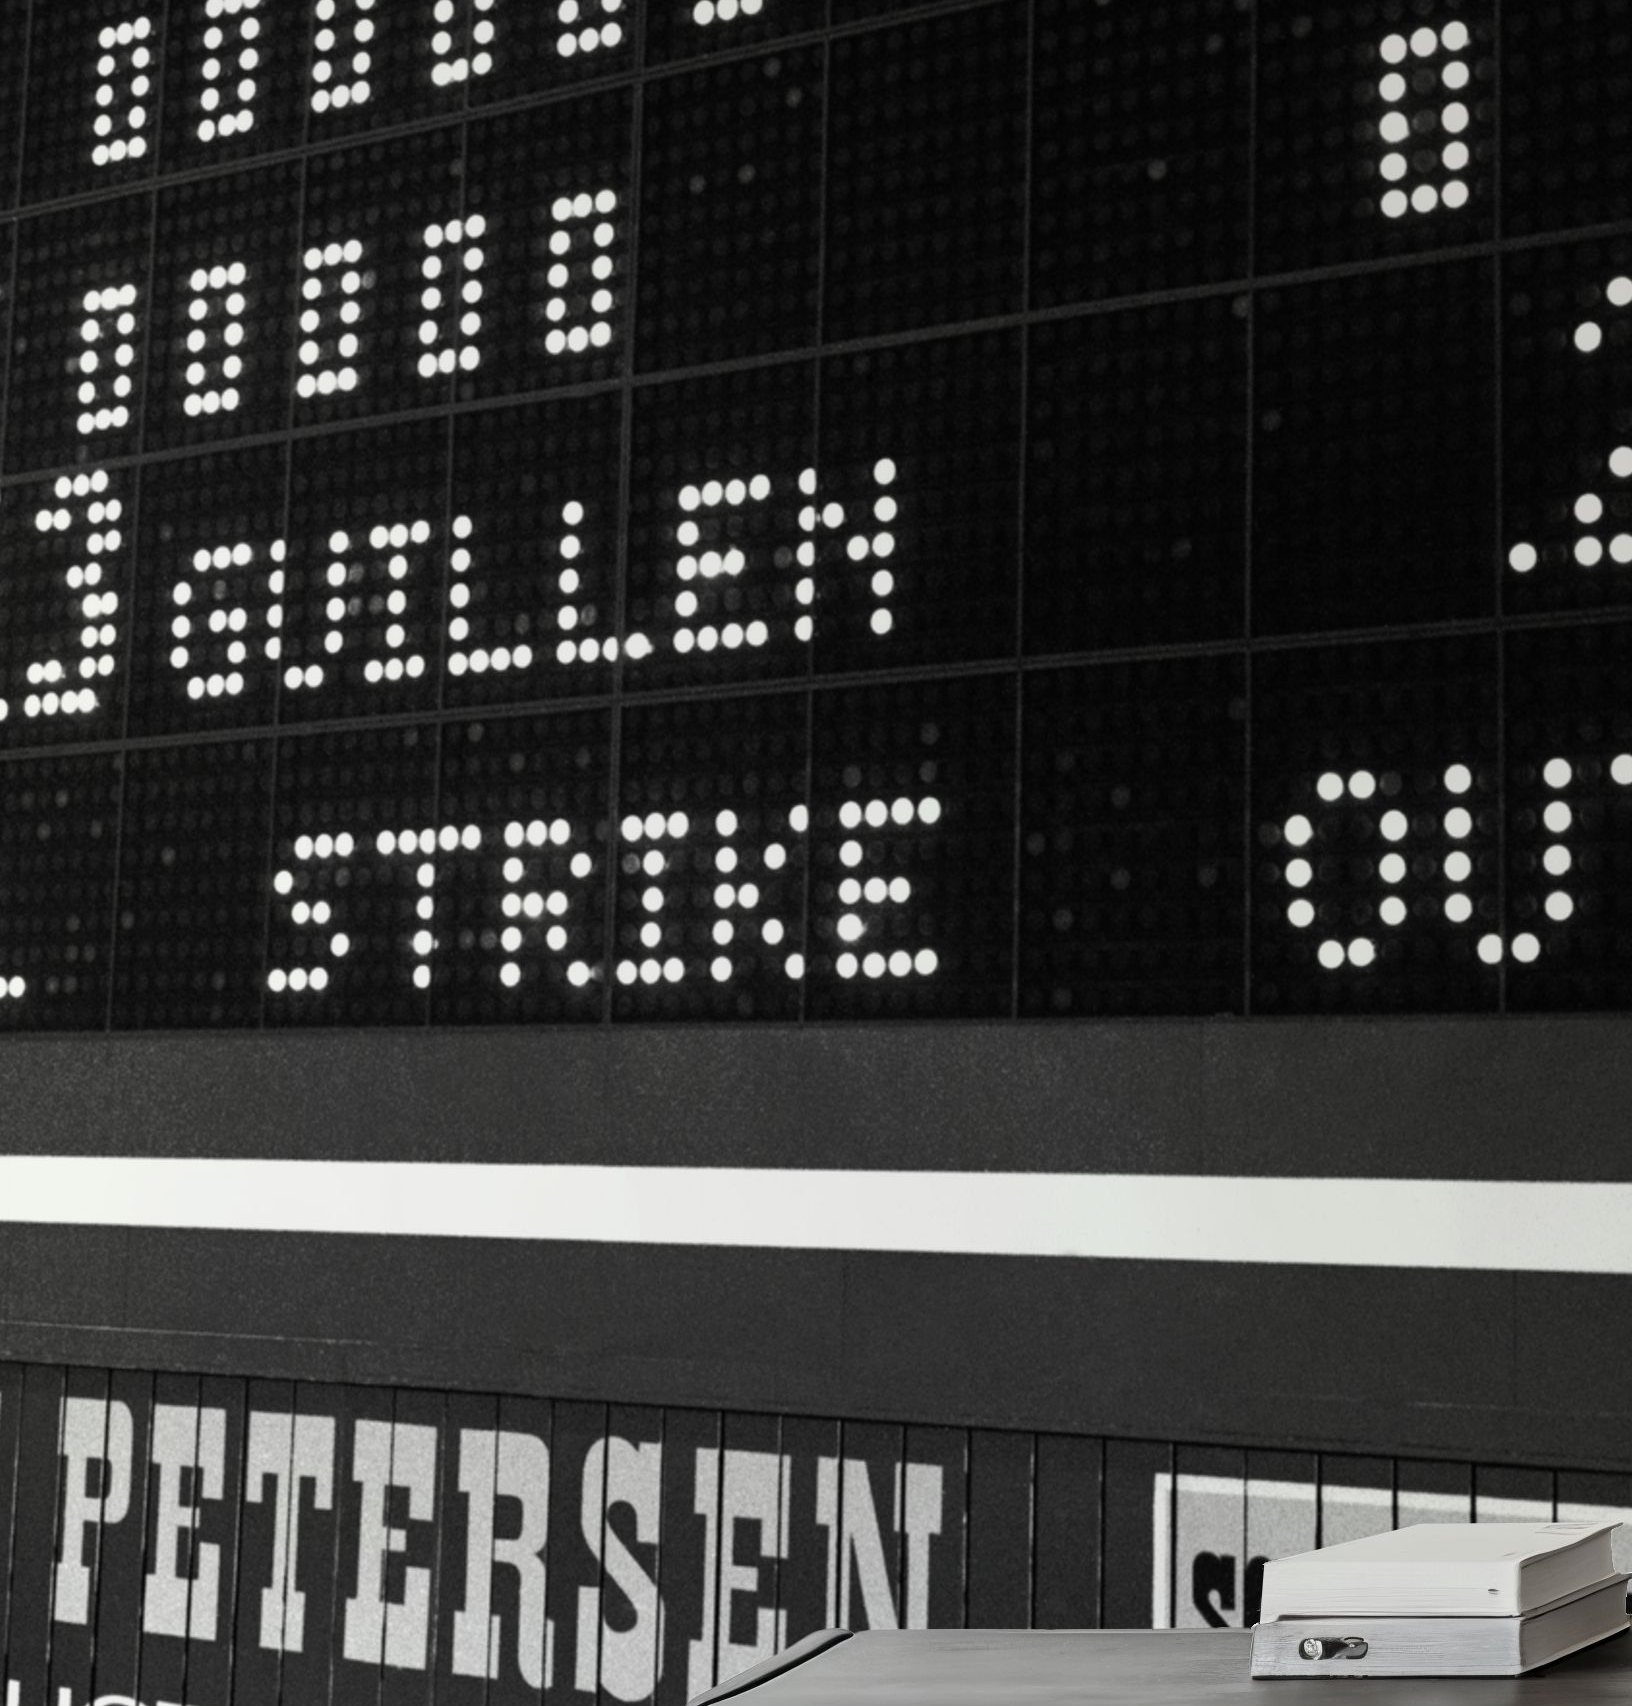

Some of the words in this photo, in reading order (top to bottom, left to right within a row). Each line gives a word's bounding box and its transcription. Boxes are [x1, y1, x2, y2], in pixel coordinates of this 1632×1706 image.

[170, 459, 897, 699] GUILLEN
[267, 797, 941, 992] STRIKE
[54, 1397, 944, 1703] PETERSEN
